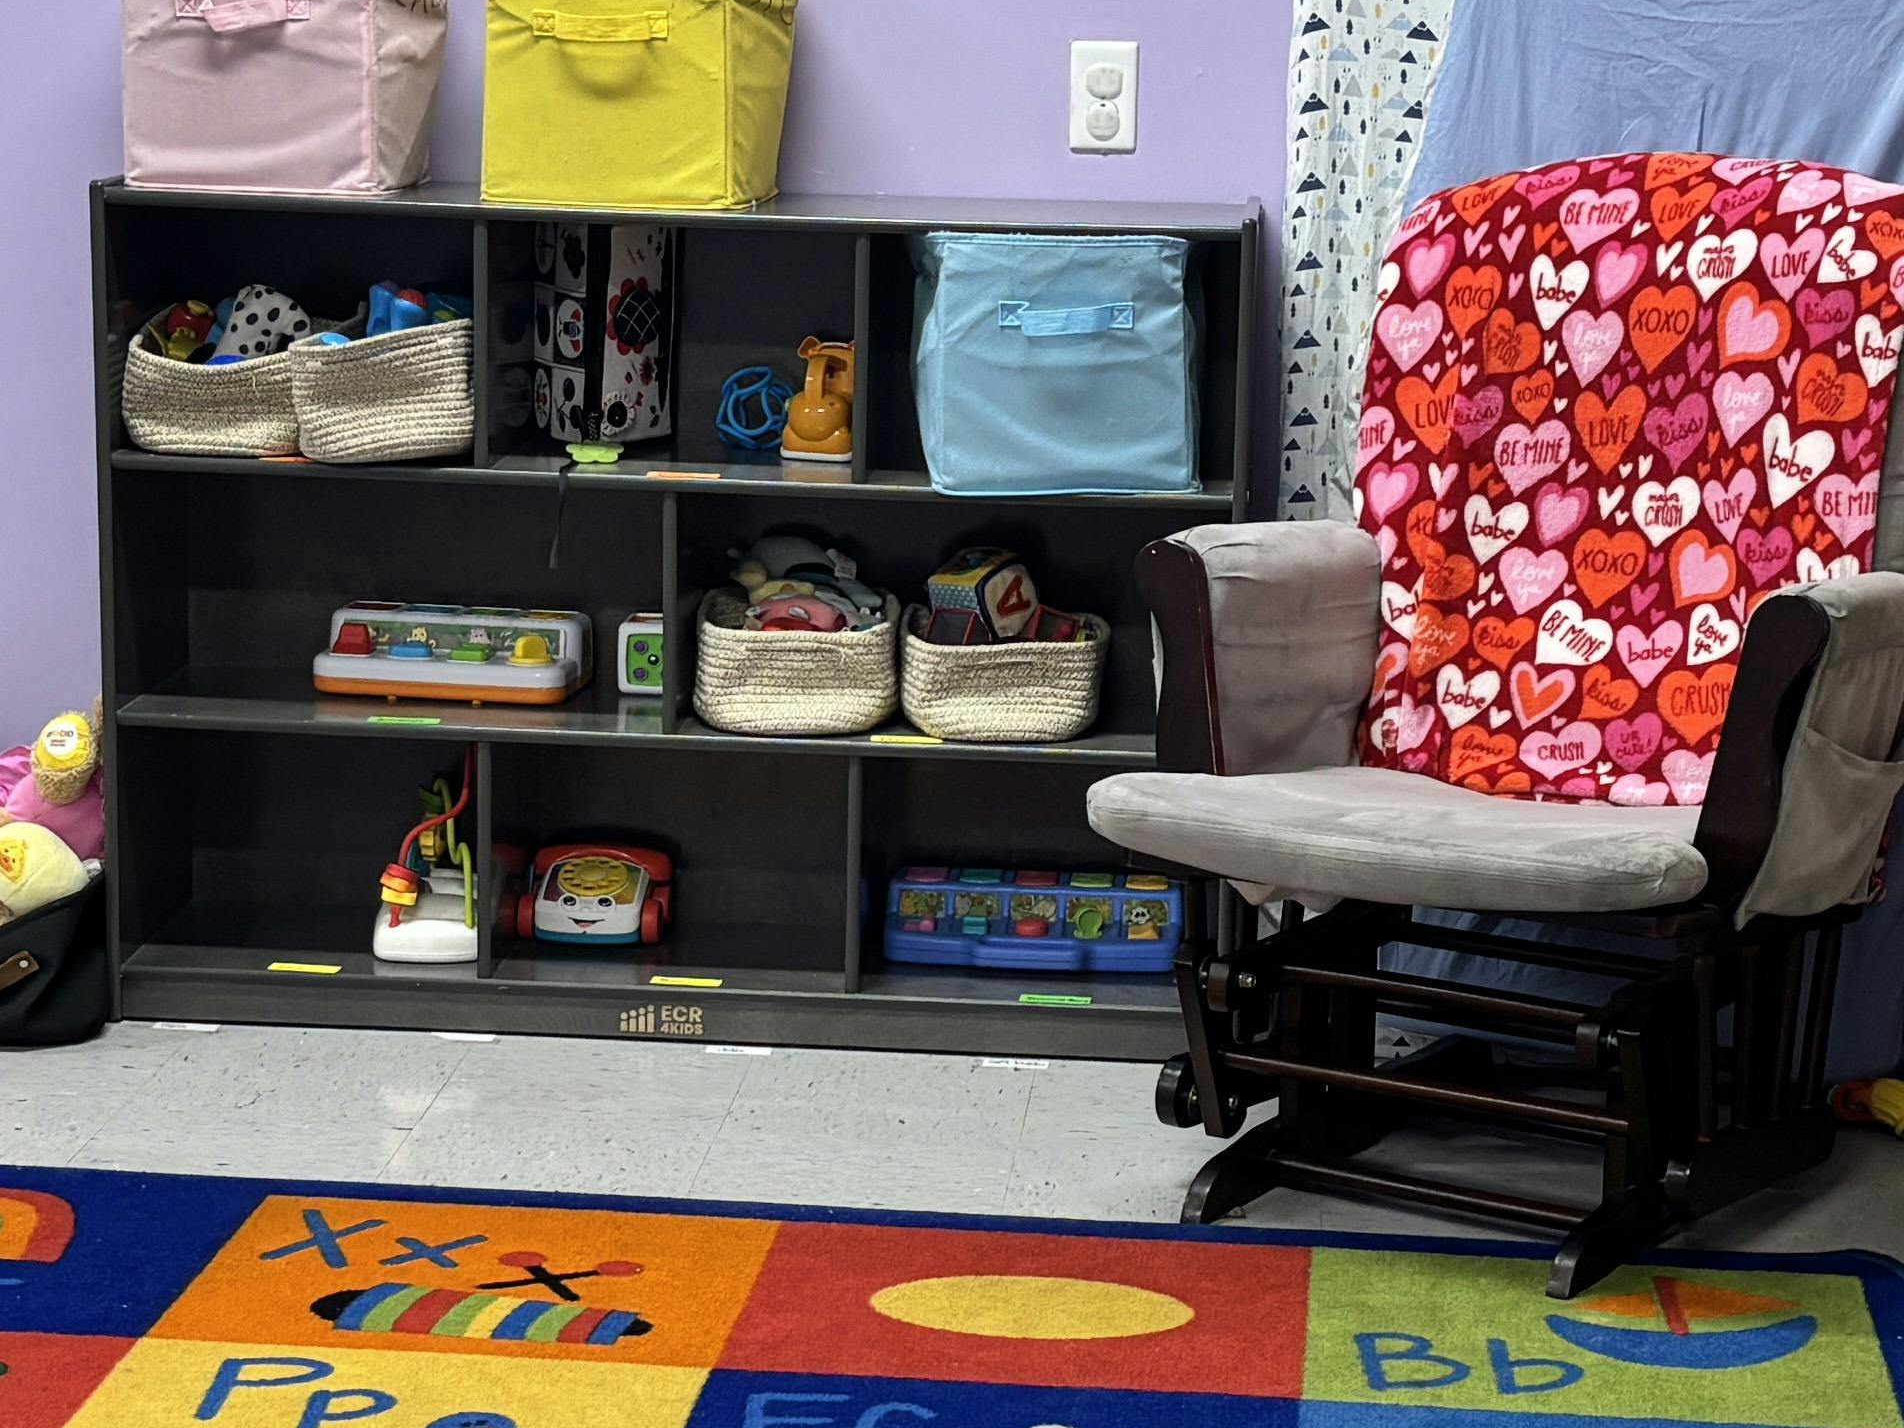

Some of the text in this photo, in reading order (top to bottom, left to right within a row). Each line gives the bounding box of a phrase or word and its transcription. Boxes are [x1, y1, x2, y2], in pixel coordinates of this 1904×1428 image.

[1564, 200, 1634, 226] BE MINE
[1659, 200, 1699, 222] LOVE
[1771, 250, 1810, 279] LOVE
[1536, 272, 1576, 304] babe
[1632, 307, 1689, 336] XOXO
[1588, 415, 1629, 446] LOVE
[1499, 437, 1563, 466] BE MINE
[1769, 437, 1813, 482] babe
[1715, 494, 1744, 523] LOVE
[1823, 491, 1843, 516] BE
[1471, 511, 1515, 541] babe
[1577, 549, 1638, 575] XOXO
[1542, 610, 1606, 662] BE MINE
[1628, 639, 1674, 663] babe
[1442, 680, 1485, 709] babe
[1538, 741, 1584, 761] CRUSH
[661, 1005, 703, 1022] ECR
[660, 1022, 704, 1035] 4KIDS
